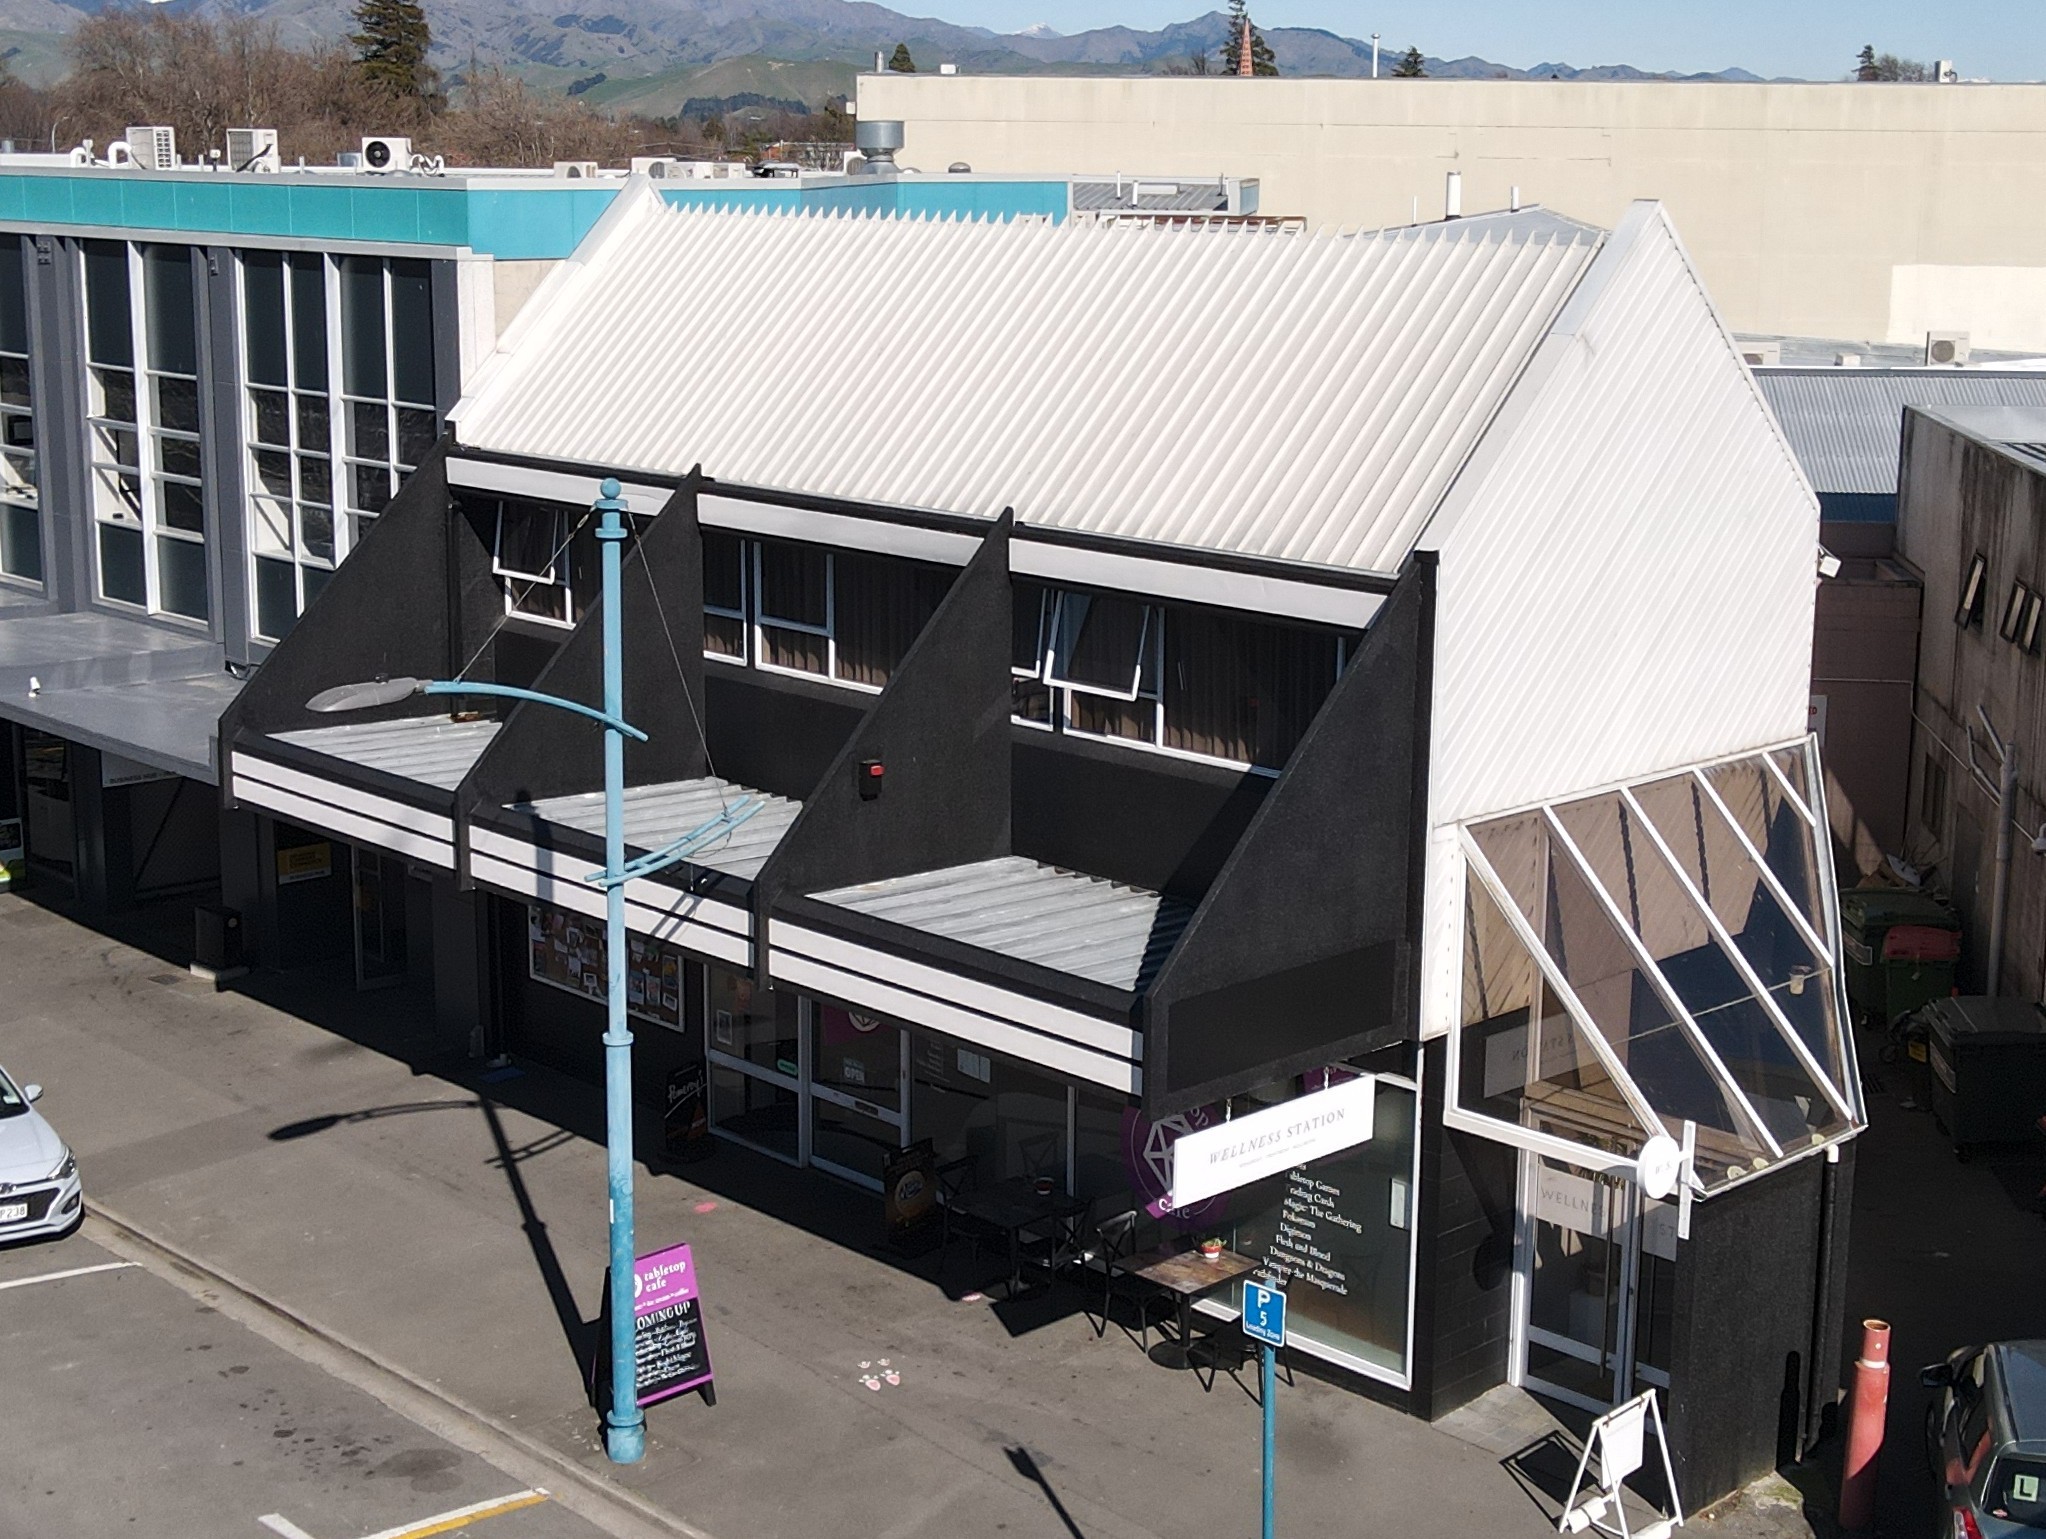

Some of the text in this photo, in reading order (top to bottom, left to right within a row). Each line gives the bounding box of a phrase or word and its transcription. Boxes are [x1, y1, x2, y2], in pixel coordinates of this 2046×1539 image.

[1210, 1130, 1281, 1165] WELLNESS
[1287, 1108, 1346, 1139] STATION
[1316, 1180, 1340, 1197] Games
[1314, 1193, 1335, 1209] Cards
[1309, 1205, 1324, 1219] The
[1325, 1211, 1362, 1234] Gathering
[1280, 1222, 1312, 1241] Digimon
[1275, 1234, 1330, 1262] Flesh and Blood
[644, 1261, 686, 1282] tabletop
[1269, 1245, 1346, 1281] Dungeons & Dragons
[645, 1277, 667, 1293] cafe
[1306, 1272, 1348, 1296] Masquerade
[1257, 1288, 1271, 1309] P
[635, 1301, 691, 1331] OMING UP
[1259, 1310, 1268, 1327] 5
[1245, 1320, 1280, 1341] Loading Zone
[2019, 1478, 2033, 1498] L
